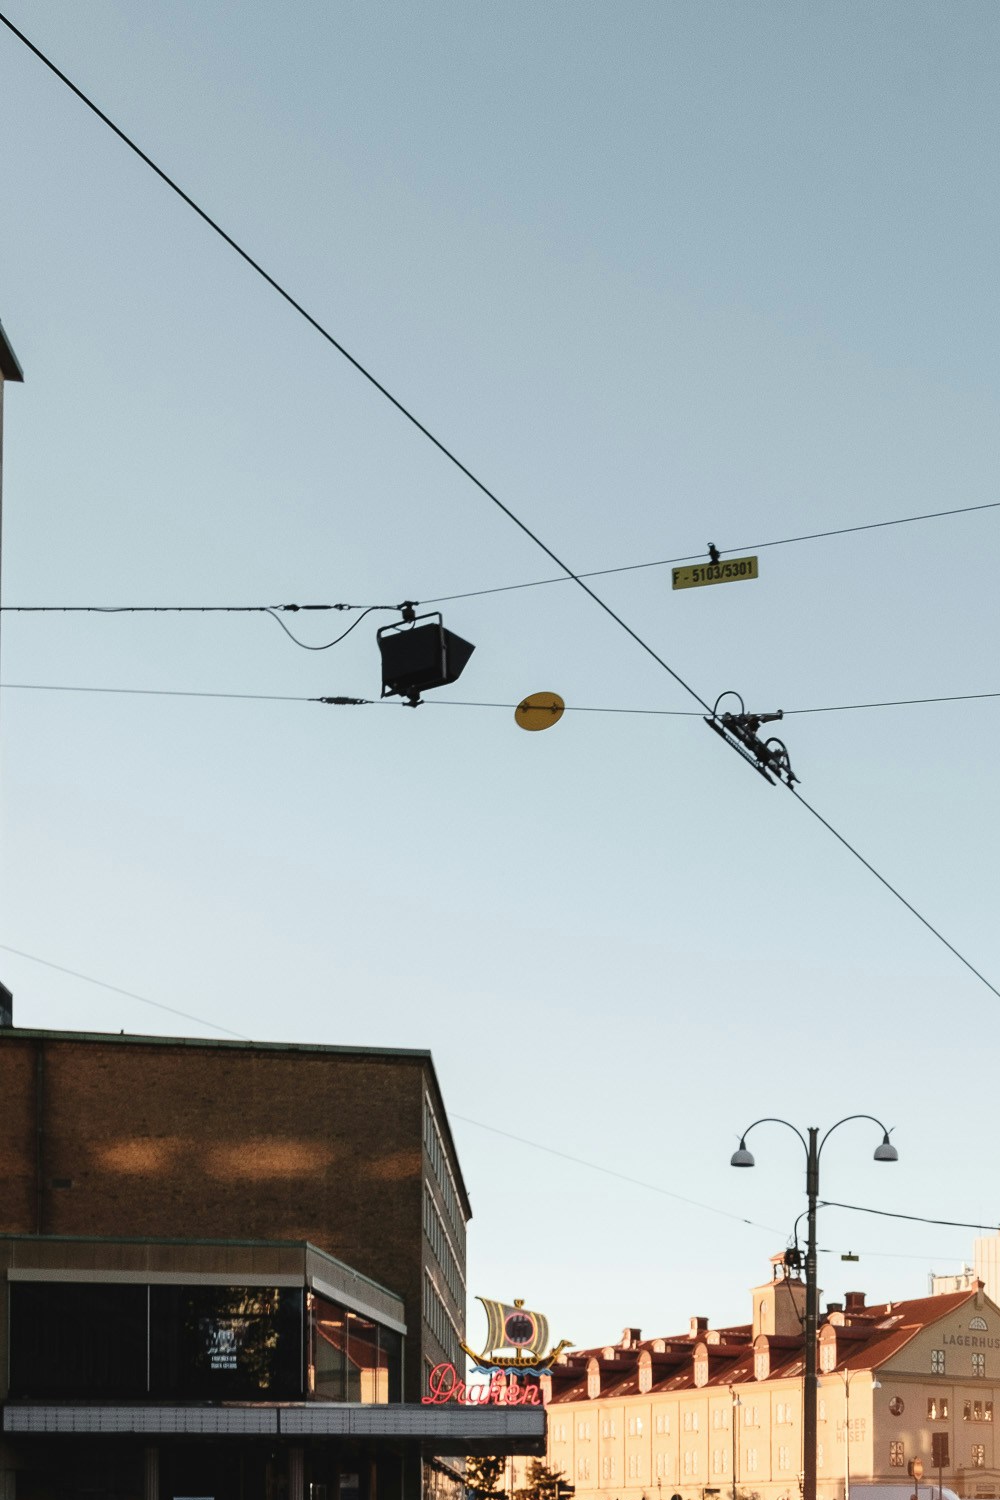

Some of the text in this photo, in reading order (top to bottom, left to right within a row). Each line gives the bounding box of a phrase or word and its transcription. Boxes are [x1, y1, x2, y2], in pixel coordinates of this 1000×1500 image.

[673, 571, 680, 585] F
[692, 561, 752, 582] 5103/5301
[421, 1363, 540, 1405] Draken
